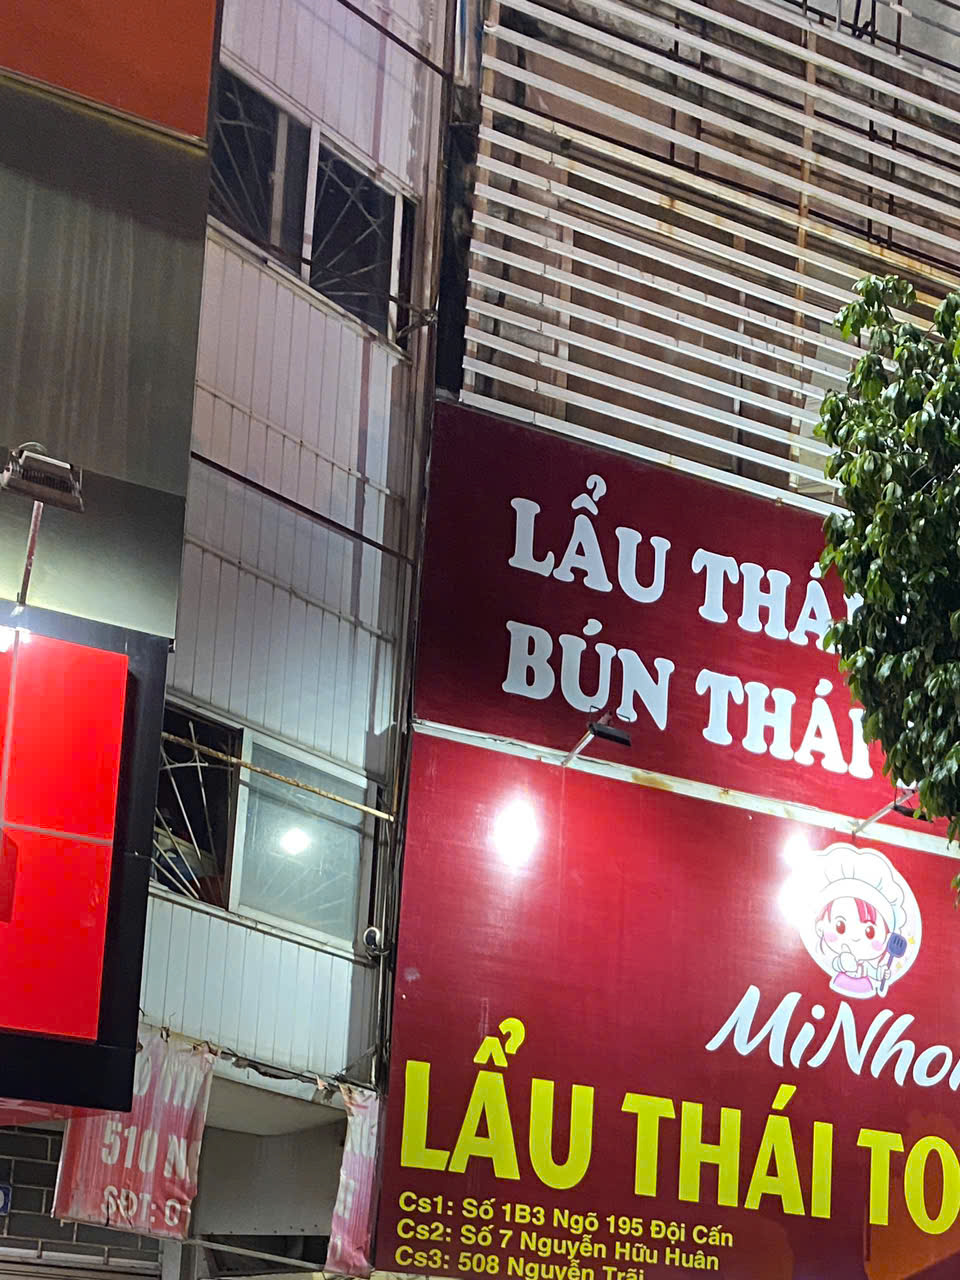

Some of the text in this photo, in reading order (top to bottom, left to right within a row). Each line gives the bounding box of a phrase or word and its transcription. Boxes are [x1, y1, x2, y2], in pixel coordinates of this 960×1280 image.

[508, 473, 671, 604] LẨU
[501, 618, 874, 780] BÚN THÁI
[400, 1017, 595, 1190] LẨU
[620, 1084, 834, 1219] THÁI
[101, 1119, 158, 1174] 510
[396, 1218, 719, 1271] Cs2: Số 7 Nguyễn Hữu Huân
[399, 1191, 733, 1247] Cs1: Số 1B3 Ngõ 195 Đội Cấn
[395, 1245, 450, 1269] Cs3:
[458, 1252, 499, 1275] 508
